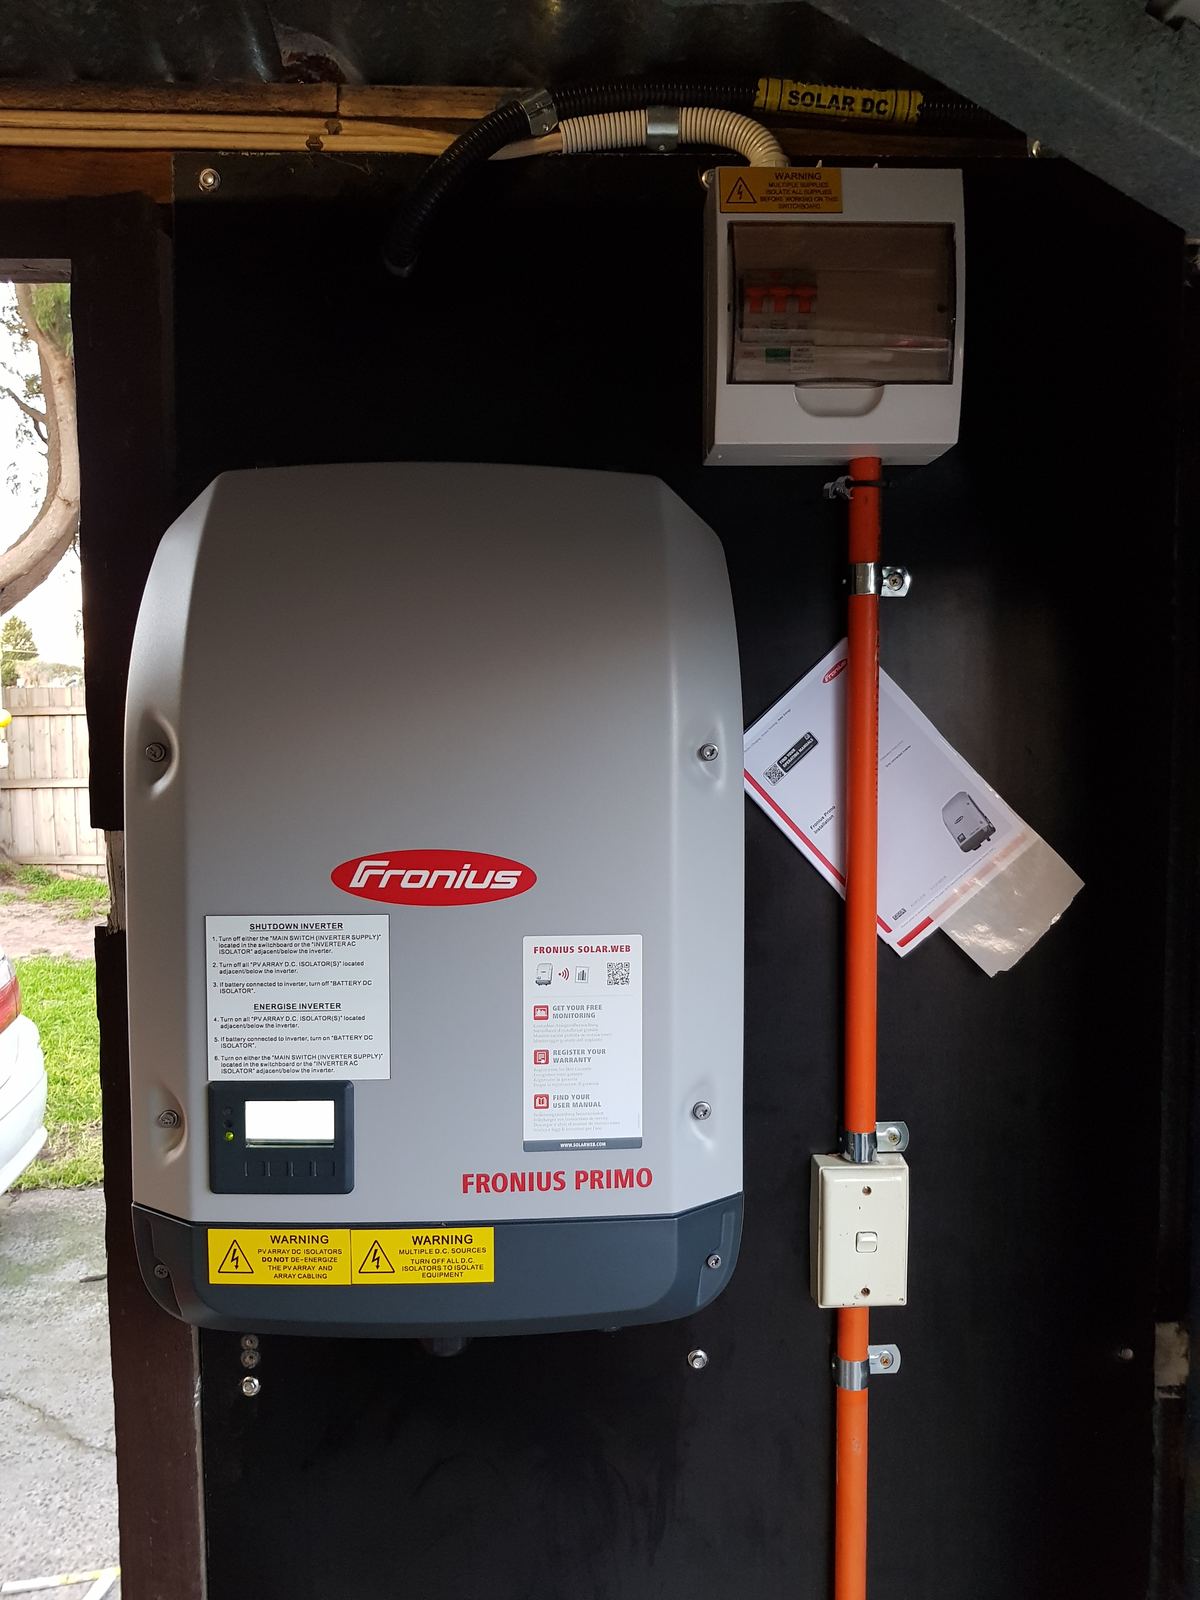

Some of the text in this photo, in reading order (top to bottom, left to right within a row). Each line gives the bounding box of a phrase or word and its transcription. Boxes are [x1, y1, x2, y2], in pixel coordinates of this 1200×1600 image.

[788, 90, 888, 116] SOLAR DC
[774, 172, 822, 180] WARNING
[349, 860, 522, 889] Fronius
[534, 945, 631, 954] FRONIUS SOLAR.WEB
[462, 1168, 652, 1193] FRONIUS PRIMO
[270, 1235, 329, 1244] WARNING
[412, 1234, 473, 1245] WARNING
